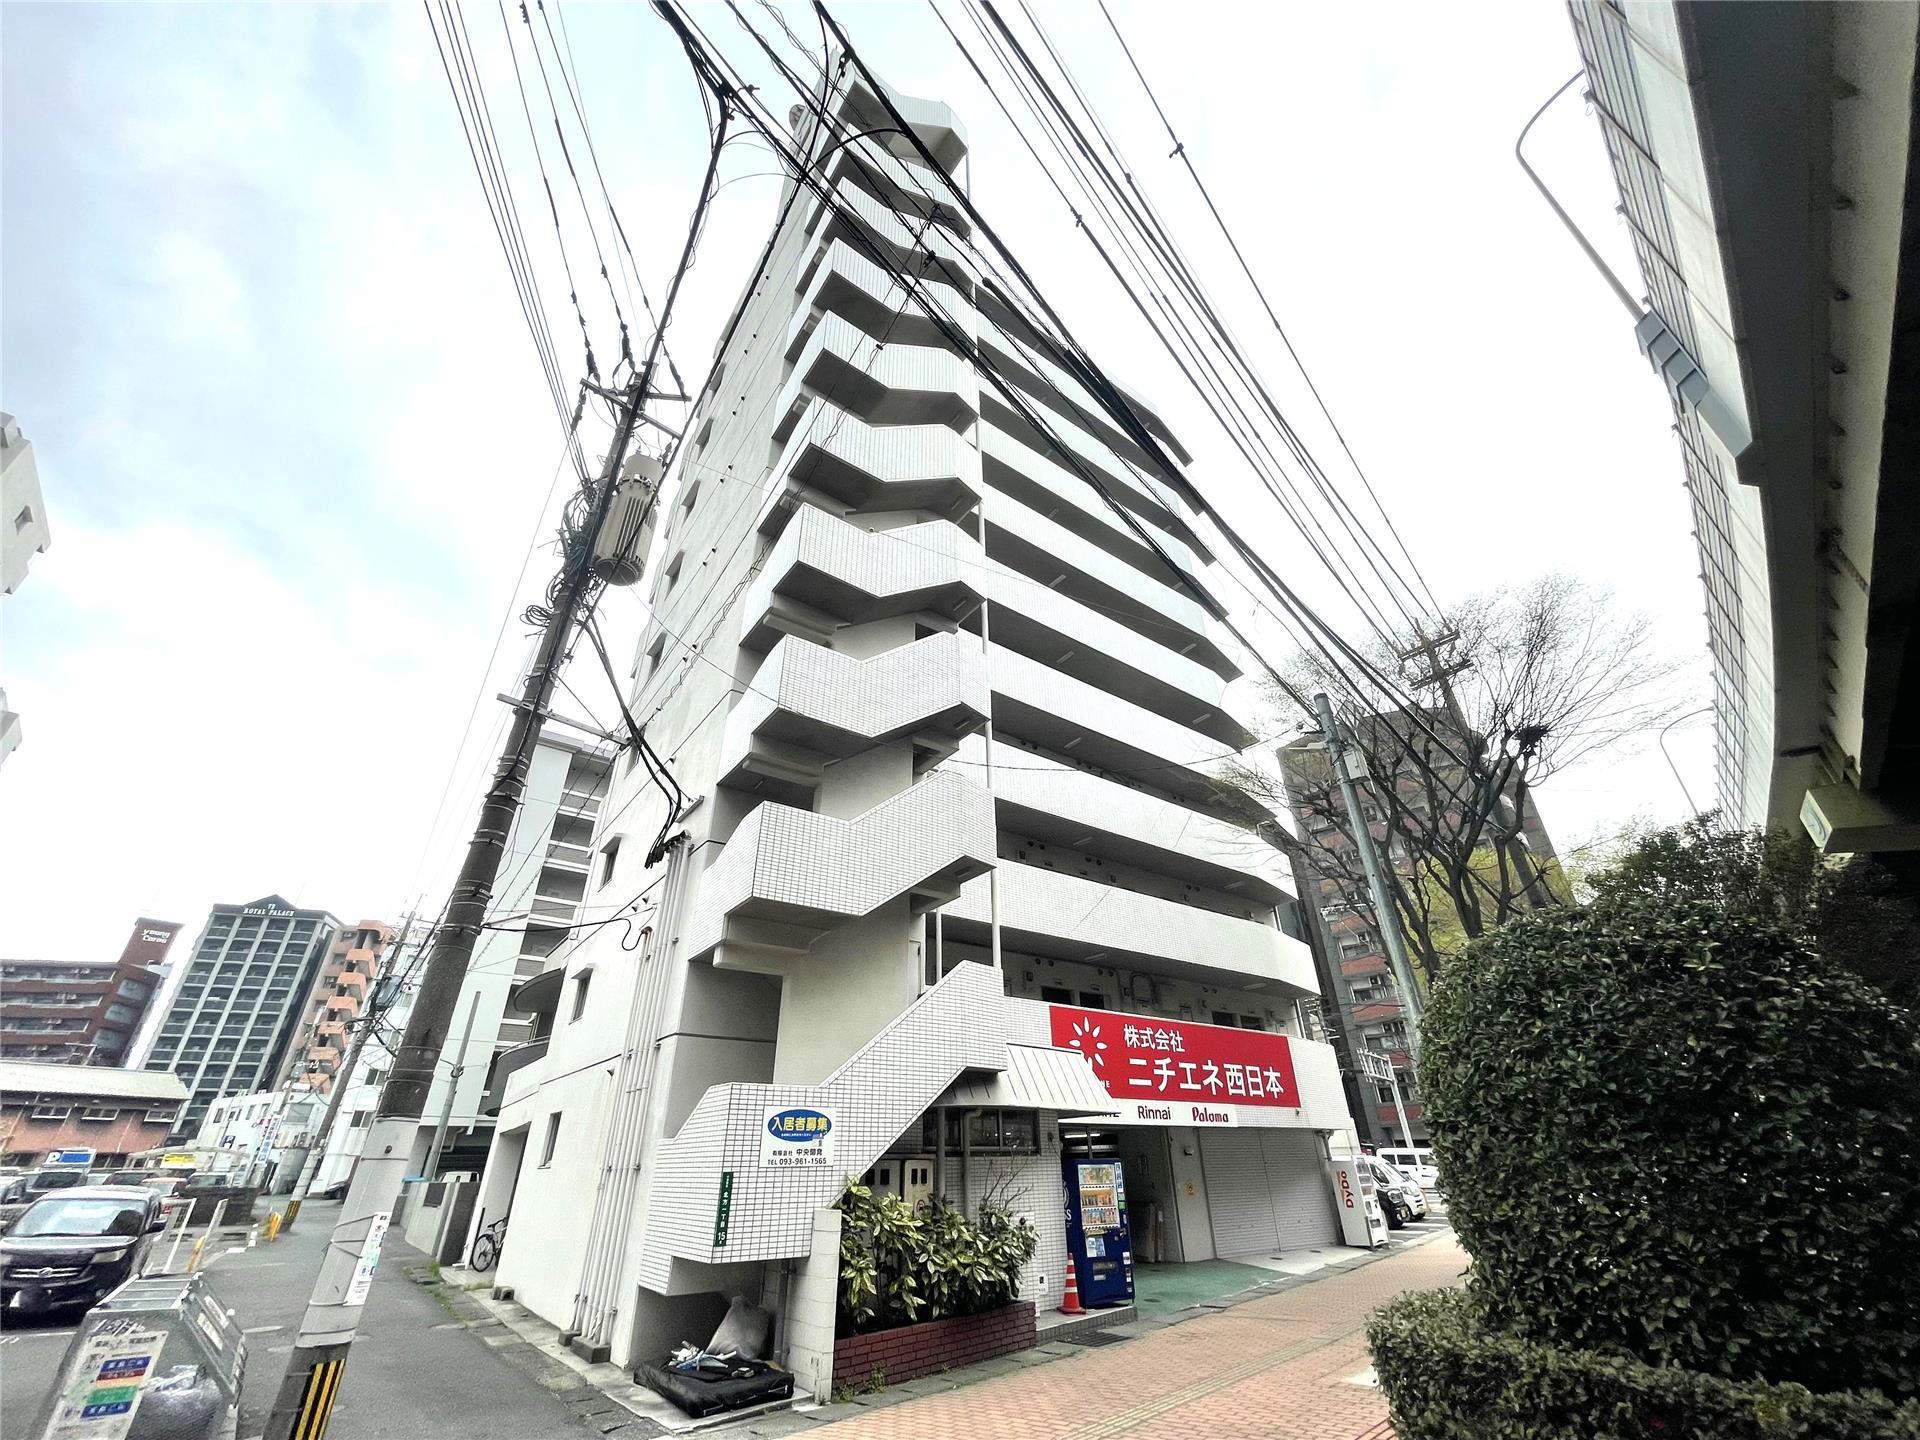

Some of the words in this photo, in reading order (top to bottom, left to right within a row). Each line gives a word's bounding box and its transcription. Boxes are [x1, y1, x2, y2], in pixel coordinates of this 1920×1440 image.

[243, 907, 266, 915] ROYAL
[268, 909, 295, 917] PALACE
[1123, 1023, 1186, 1053] 株式会社
[1128, 1057, 1284, 1099] ニチエネ西日本
[1137, 1105, 1171, 1120] Rinnai
[1192, 1106, 1229, 1123] Paloma
[771, 1116, 828, 1131] 入居者募集
[779, 1157, 827, 1165] 093-961-1565
[1340, 1170, 1354, 1208] DyDo
